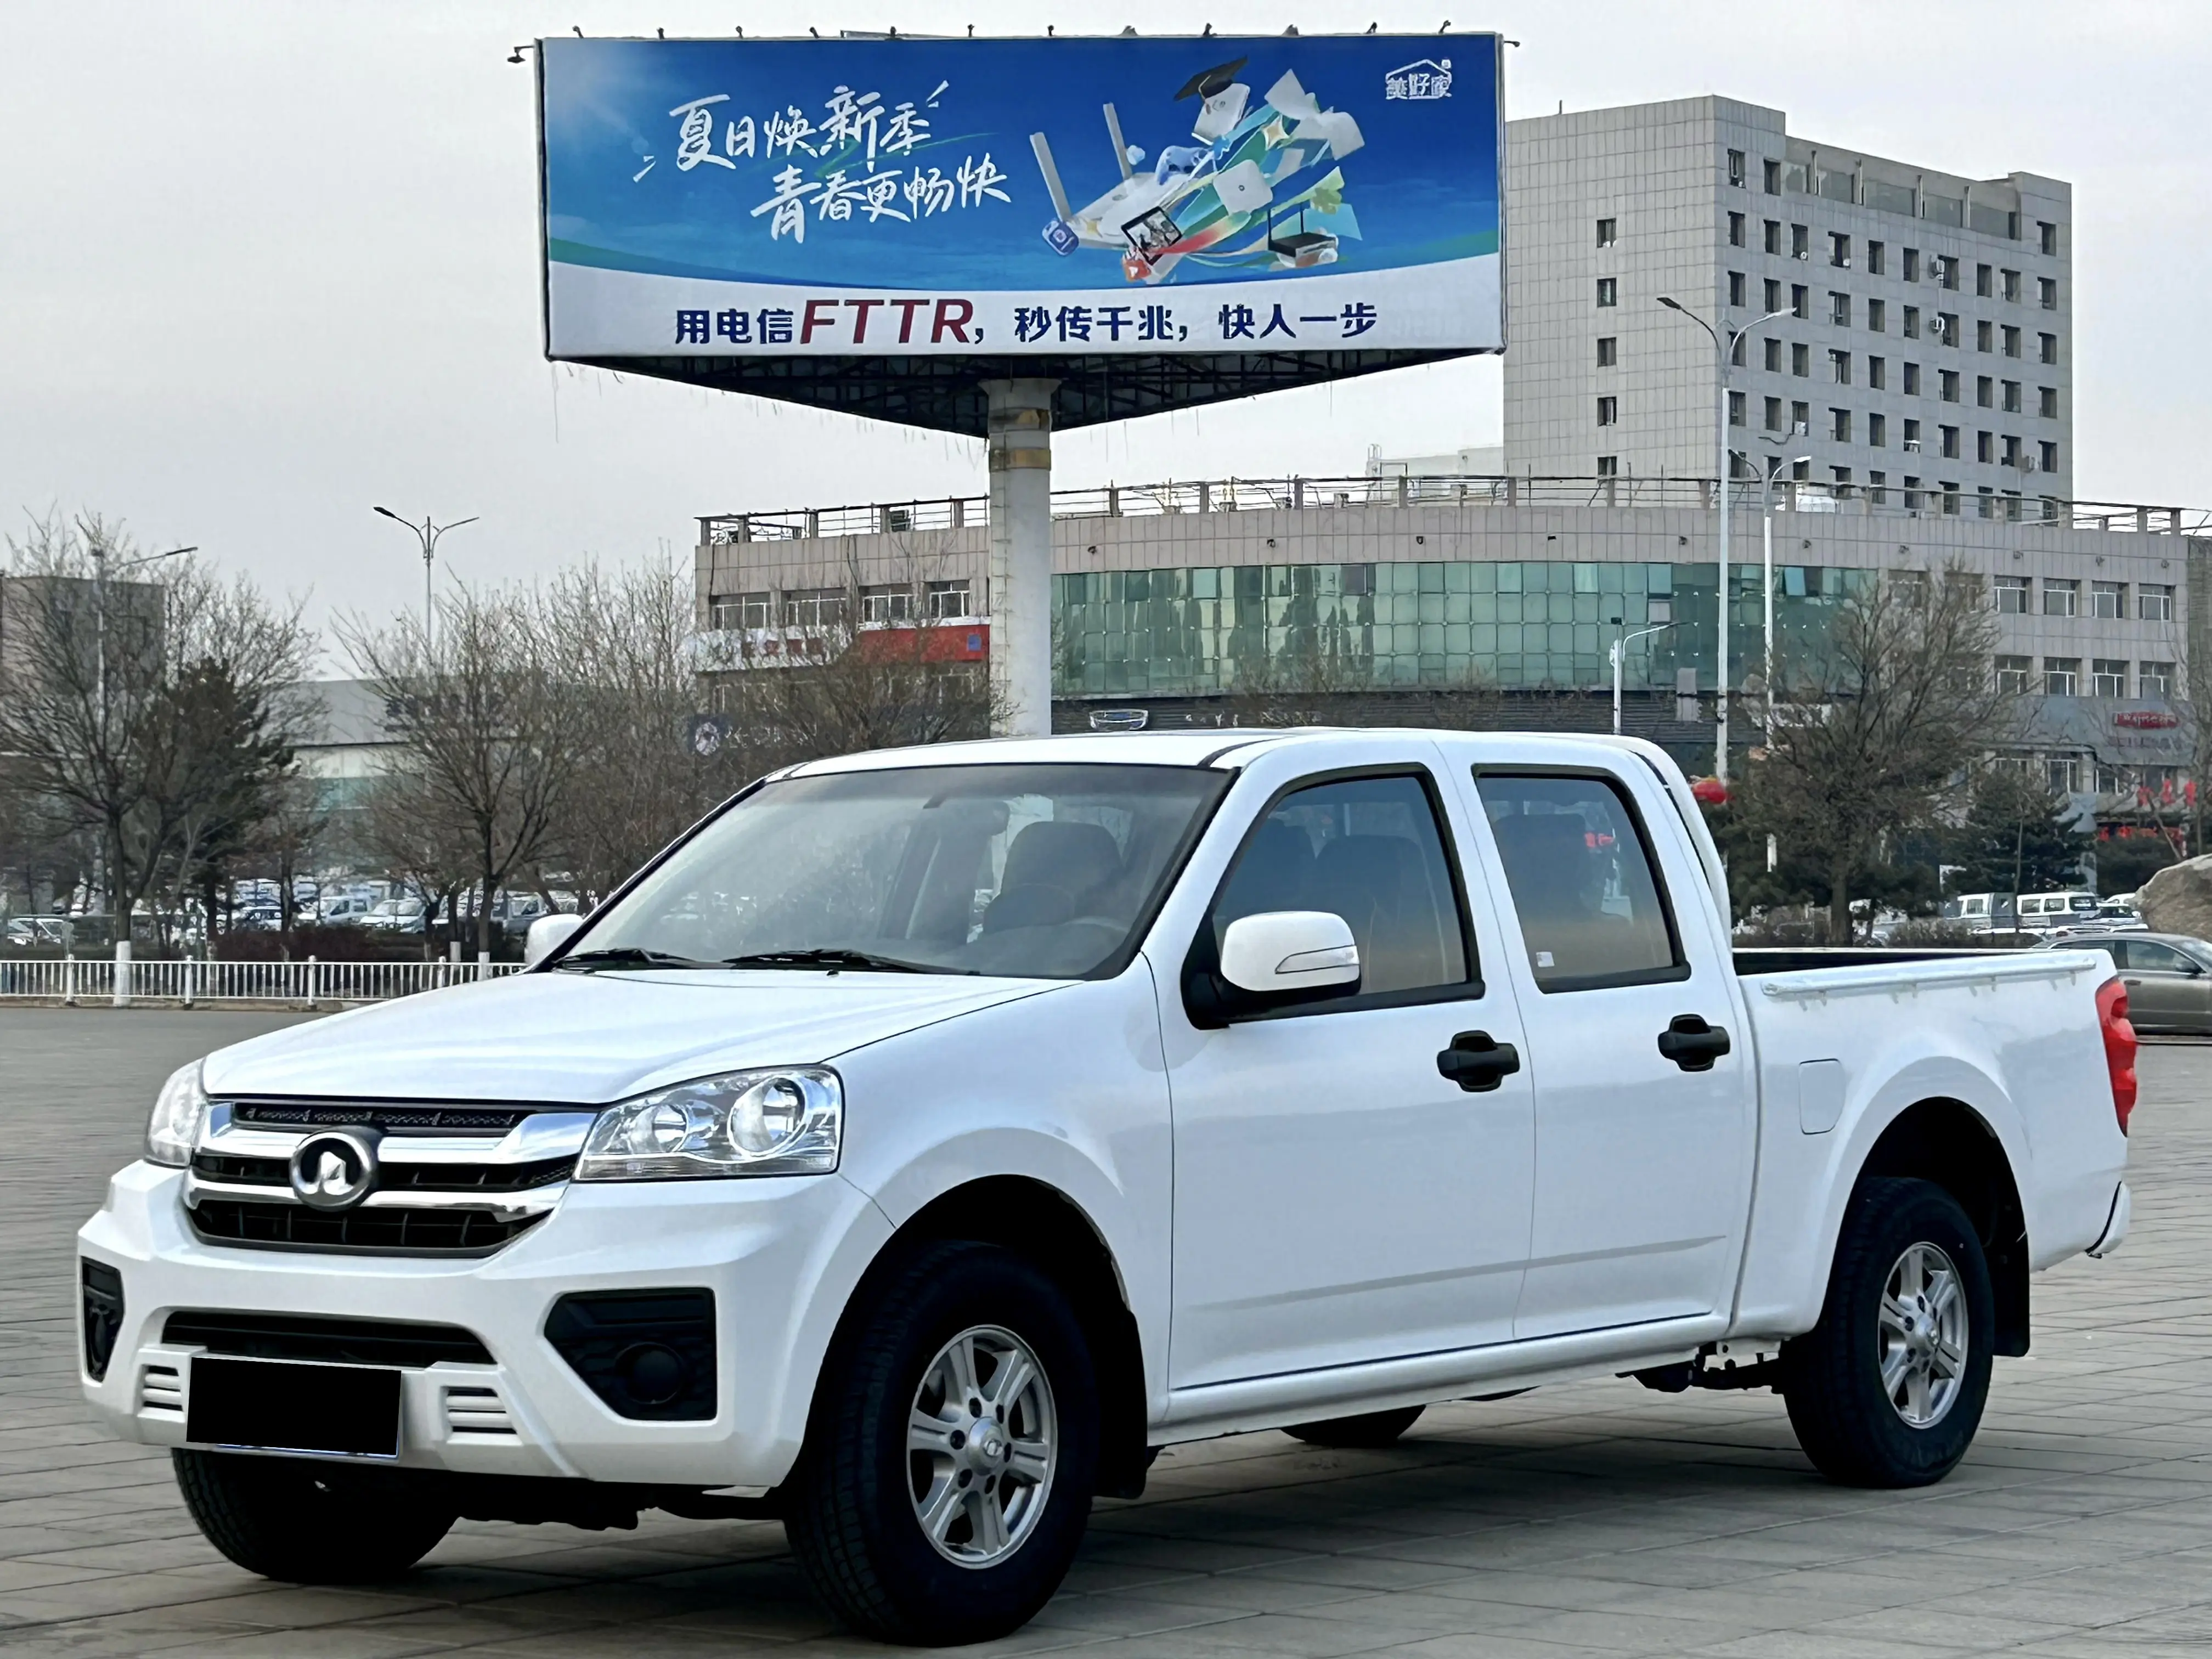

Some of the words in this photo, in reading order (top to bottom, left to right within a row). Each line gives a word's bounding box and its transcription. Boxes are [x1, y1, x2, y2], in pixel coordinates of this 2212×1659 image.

[670, 85, 931, 172] 夏日焕新季
[751, 153, 1011, 243] 青春更畅快
